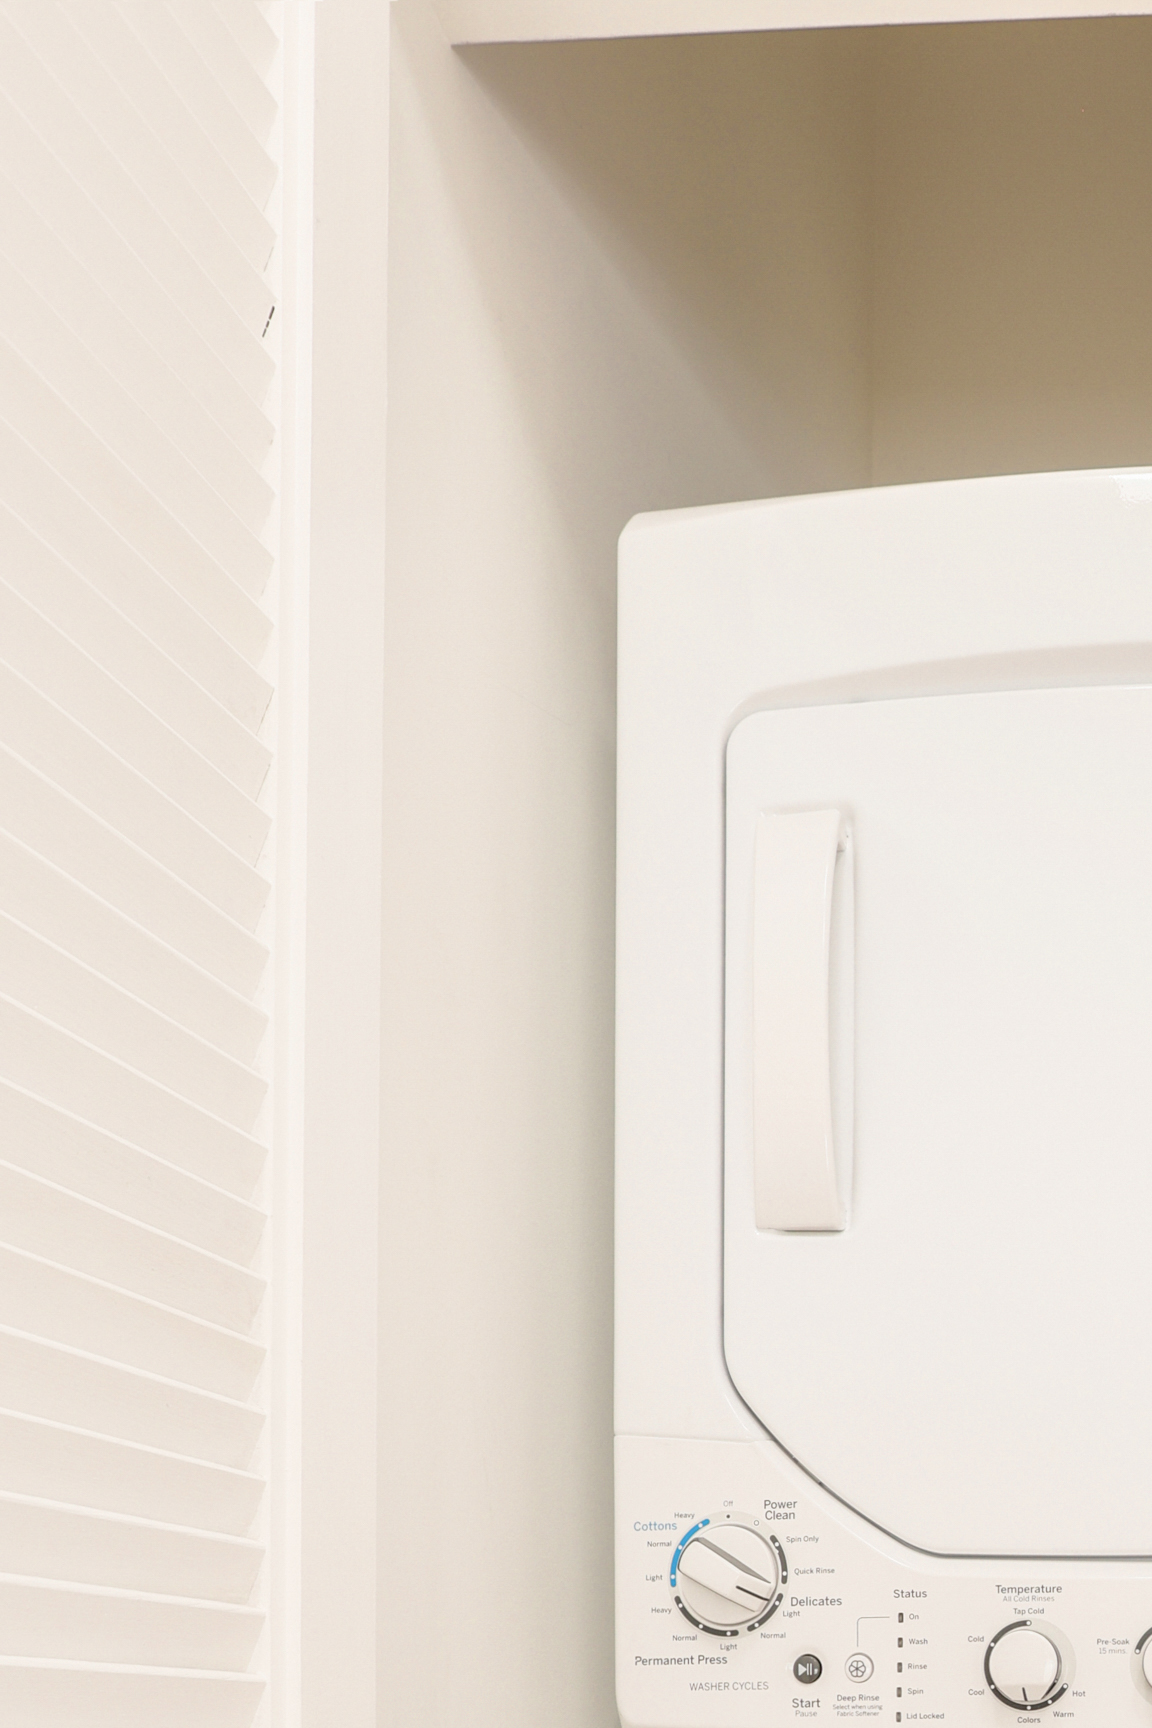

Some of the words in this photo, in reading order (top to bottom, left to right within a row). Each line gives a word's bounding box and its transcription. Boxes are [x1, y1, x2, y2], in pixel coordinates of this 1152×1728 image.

[764, 1500, 797, 1509] Power
[765, 1511, 795, 1520] Clean
[634, 1522, 677, 1531] Cottons
[794, 1568, 813, 1576] Quick
[894, 1590, 927, 1598] Status
[995, 1585, 1062, 1595] Temperature
[791, 1597, 842, 1606] Delicates
[635, 1656, 694, 1666] Permanent
[698, 1655, 727, 1664] Press
[690, 1683, 729, 1691] WASHER
[732, 1682, 769, 1690] CYCLES
[792, 1699, 820, 1708] Start
